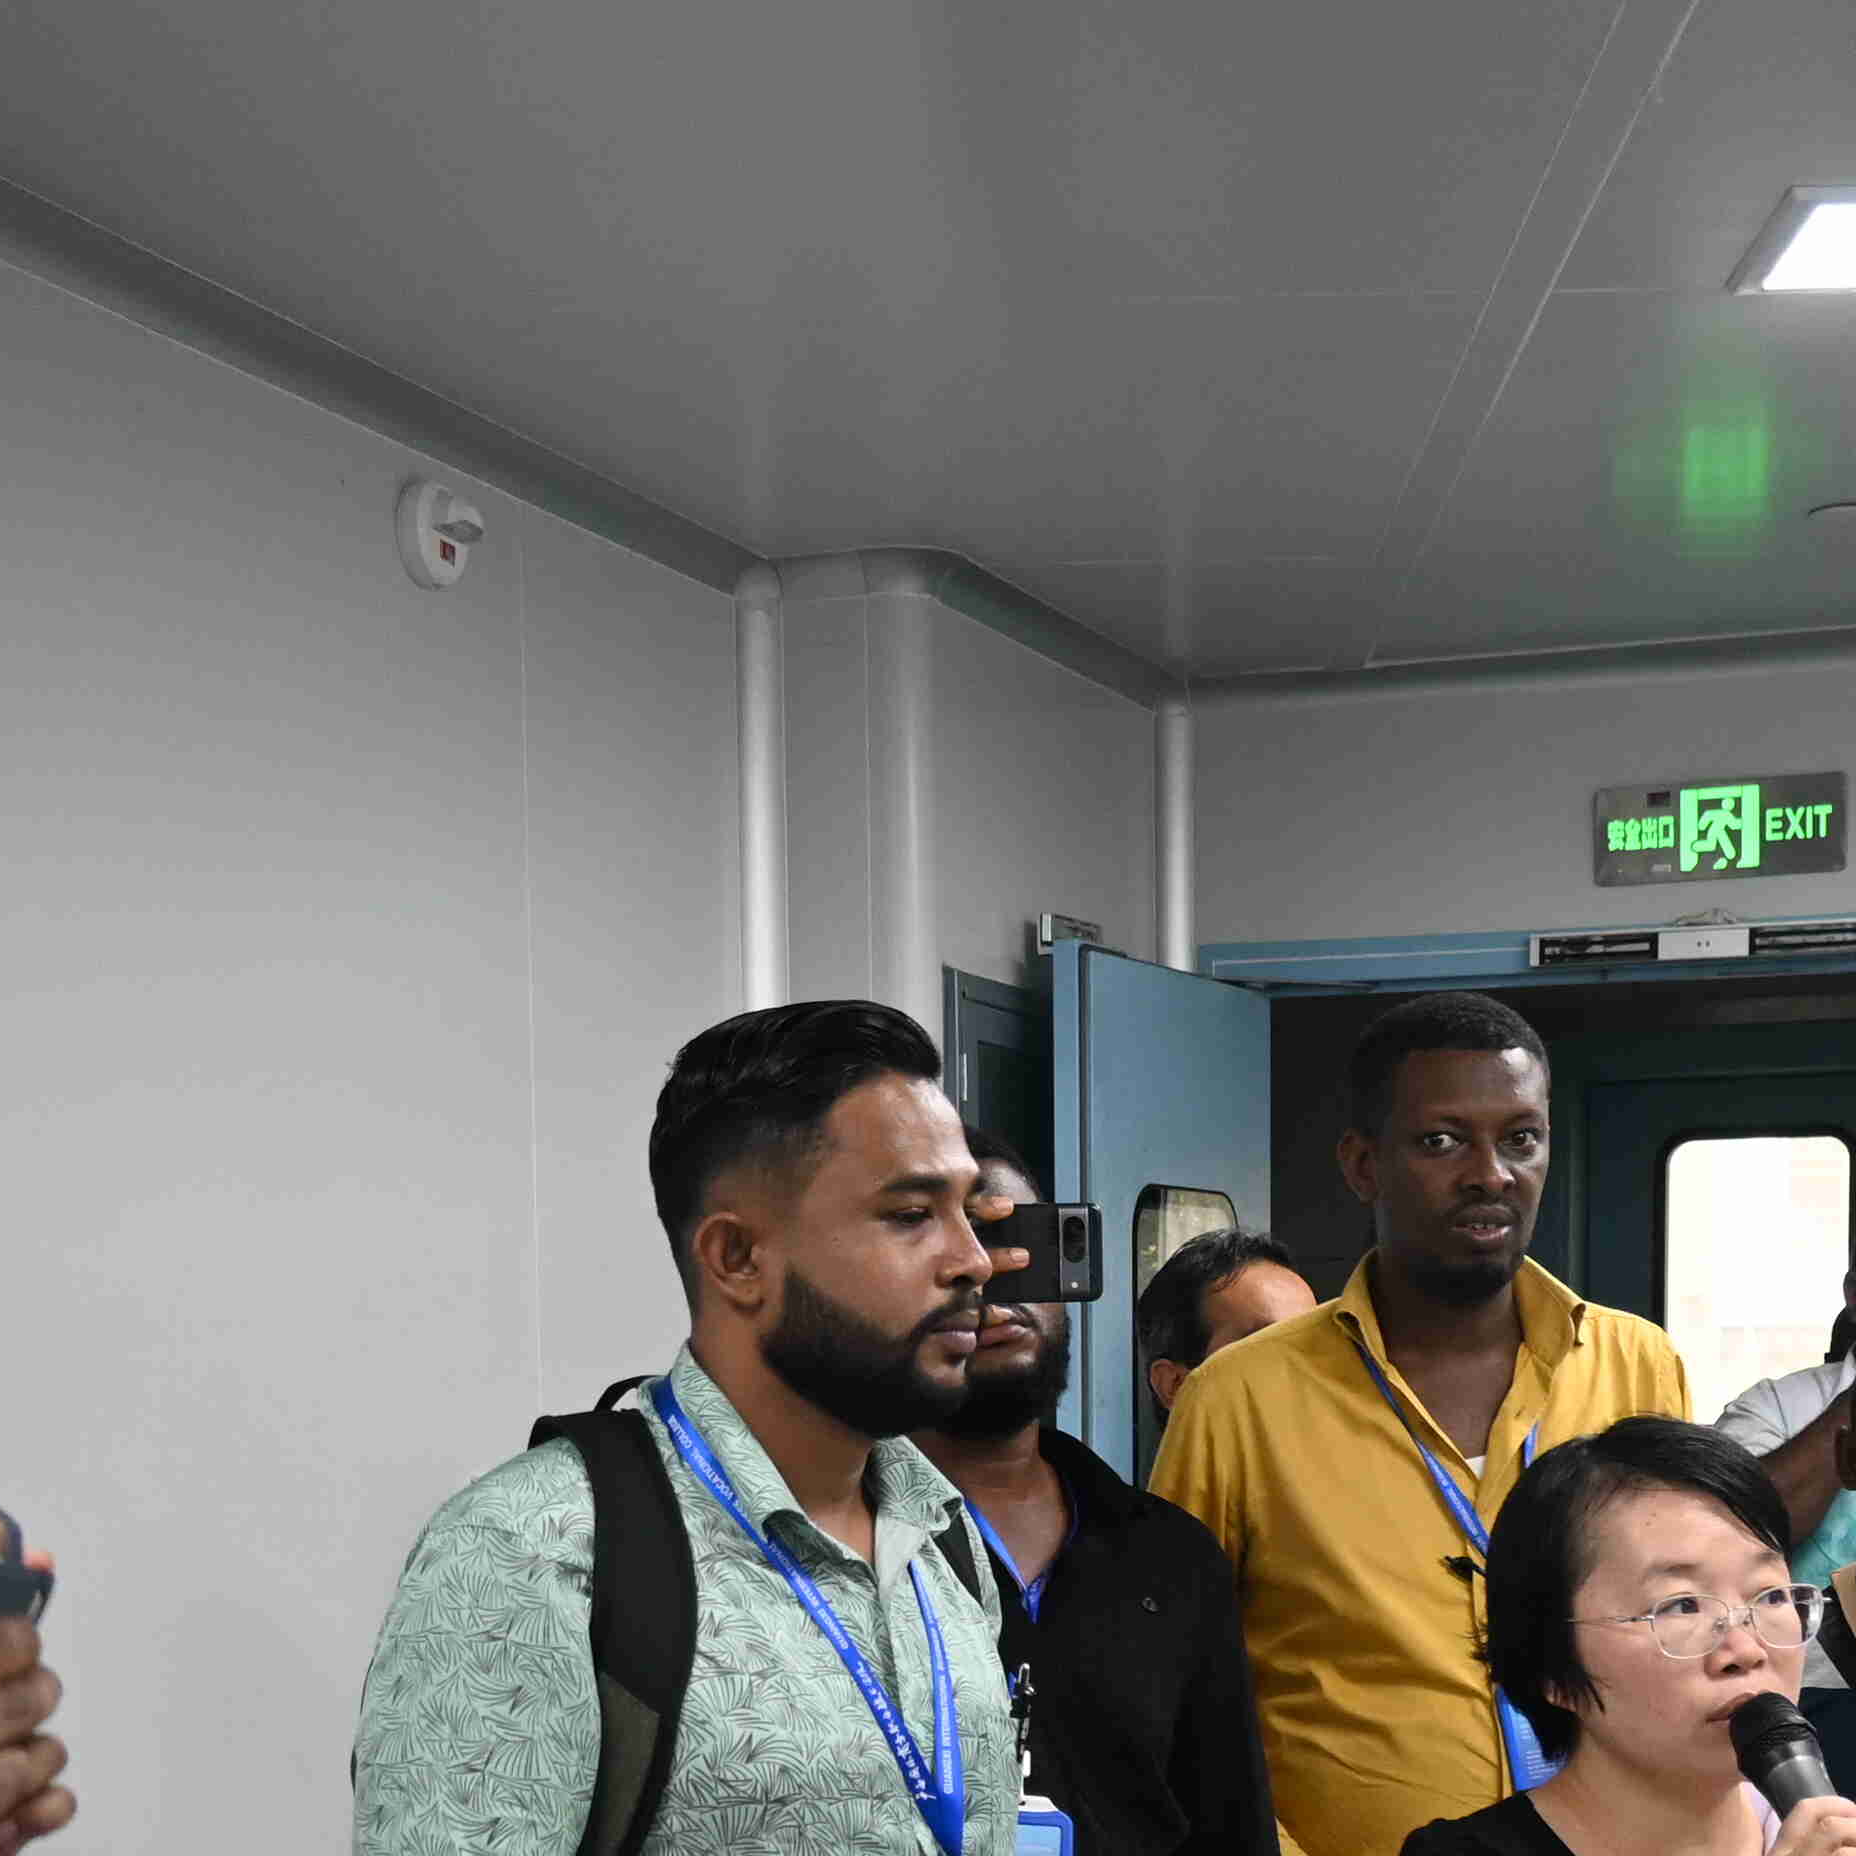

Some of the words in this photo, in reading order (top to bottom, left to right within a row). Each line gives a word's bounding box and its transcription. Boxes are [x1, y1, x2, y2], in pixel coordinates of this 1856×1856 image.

[1607, 815, 1675, 851] 安全出口
[1765, 804, 1833, 841] EXIT
